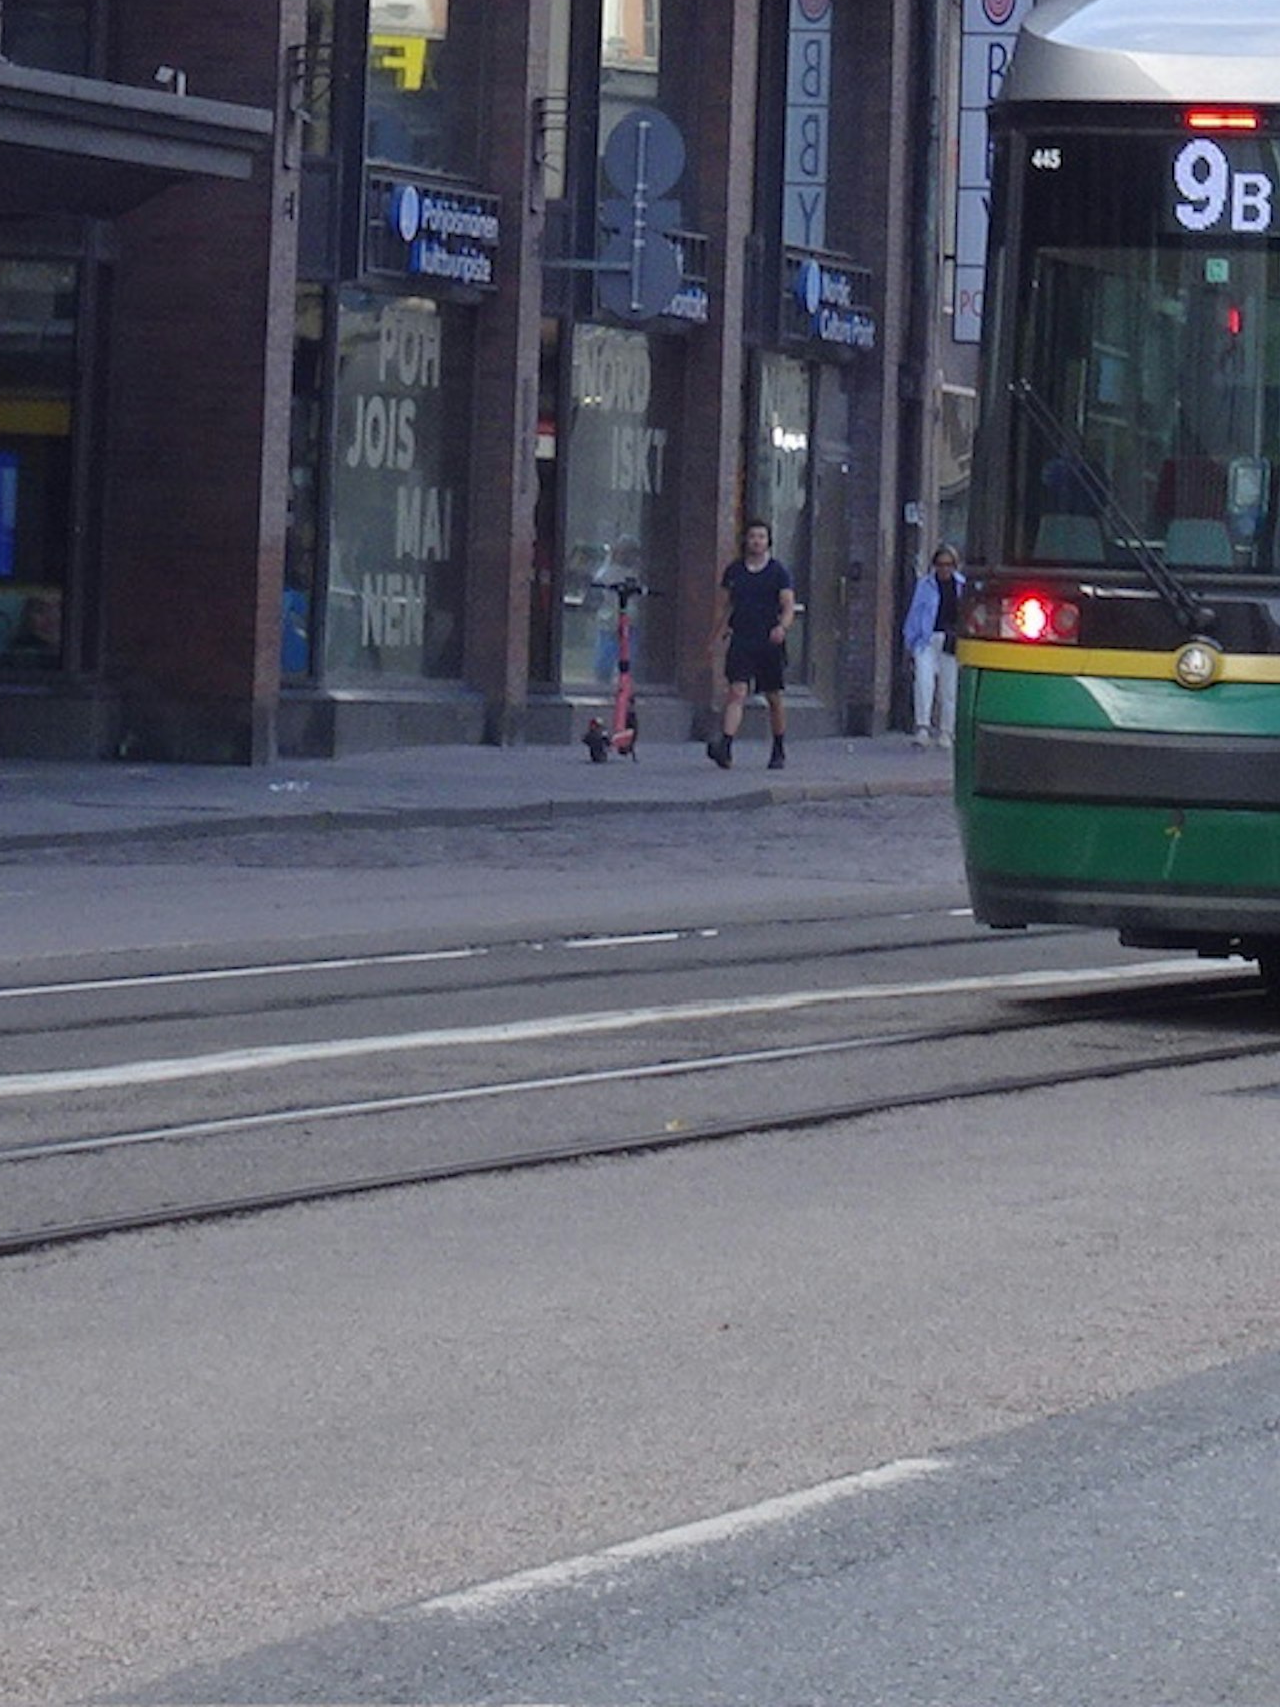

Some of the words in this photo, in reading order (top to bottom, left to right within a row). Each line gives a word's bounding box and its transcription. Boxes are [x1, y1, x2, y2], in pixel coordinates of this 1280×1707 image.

[1031, 149, 1062, 169] 445
[1173, 138, 1272, 232] 9B
[379, 307, 441, 388] POH
[346, 394, 416, 470] JOIS
[395, 487, 452, 561] MAI
[361, 572, 427, 648] NEN
